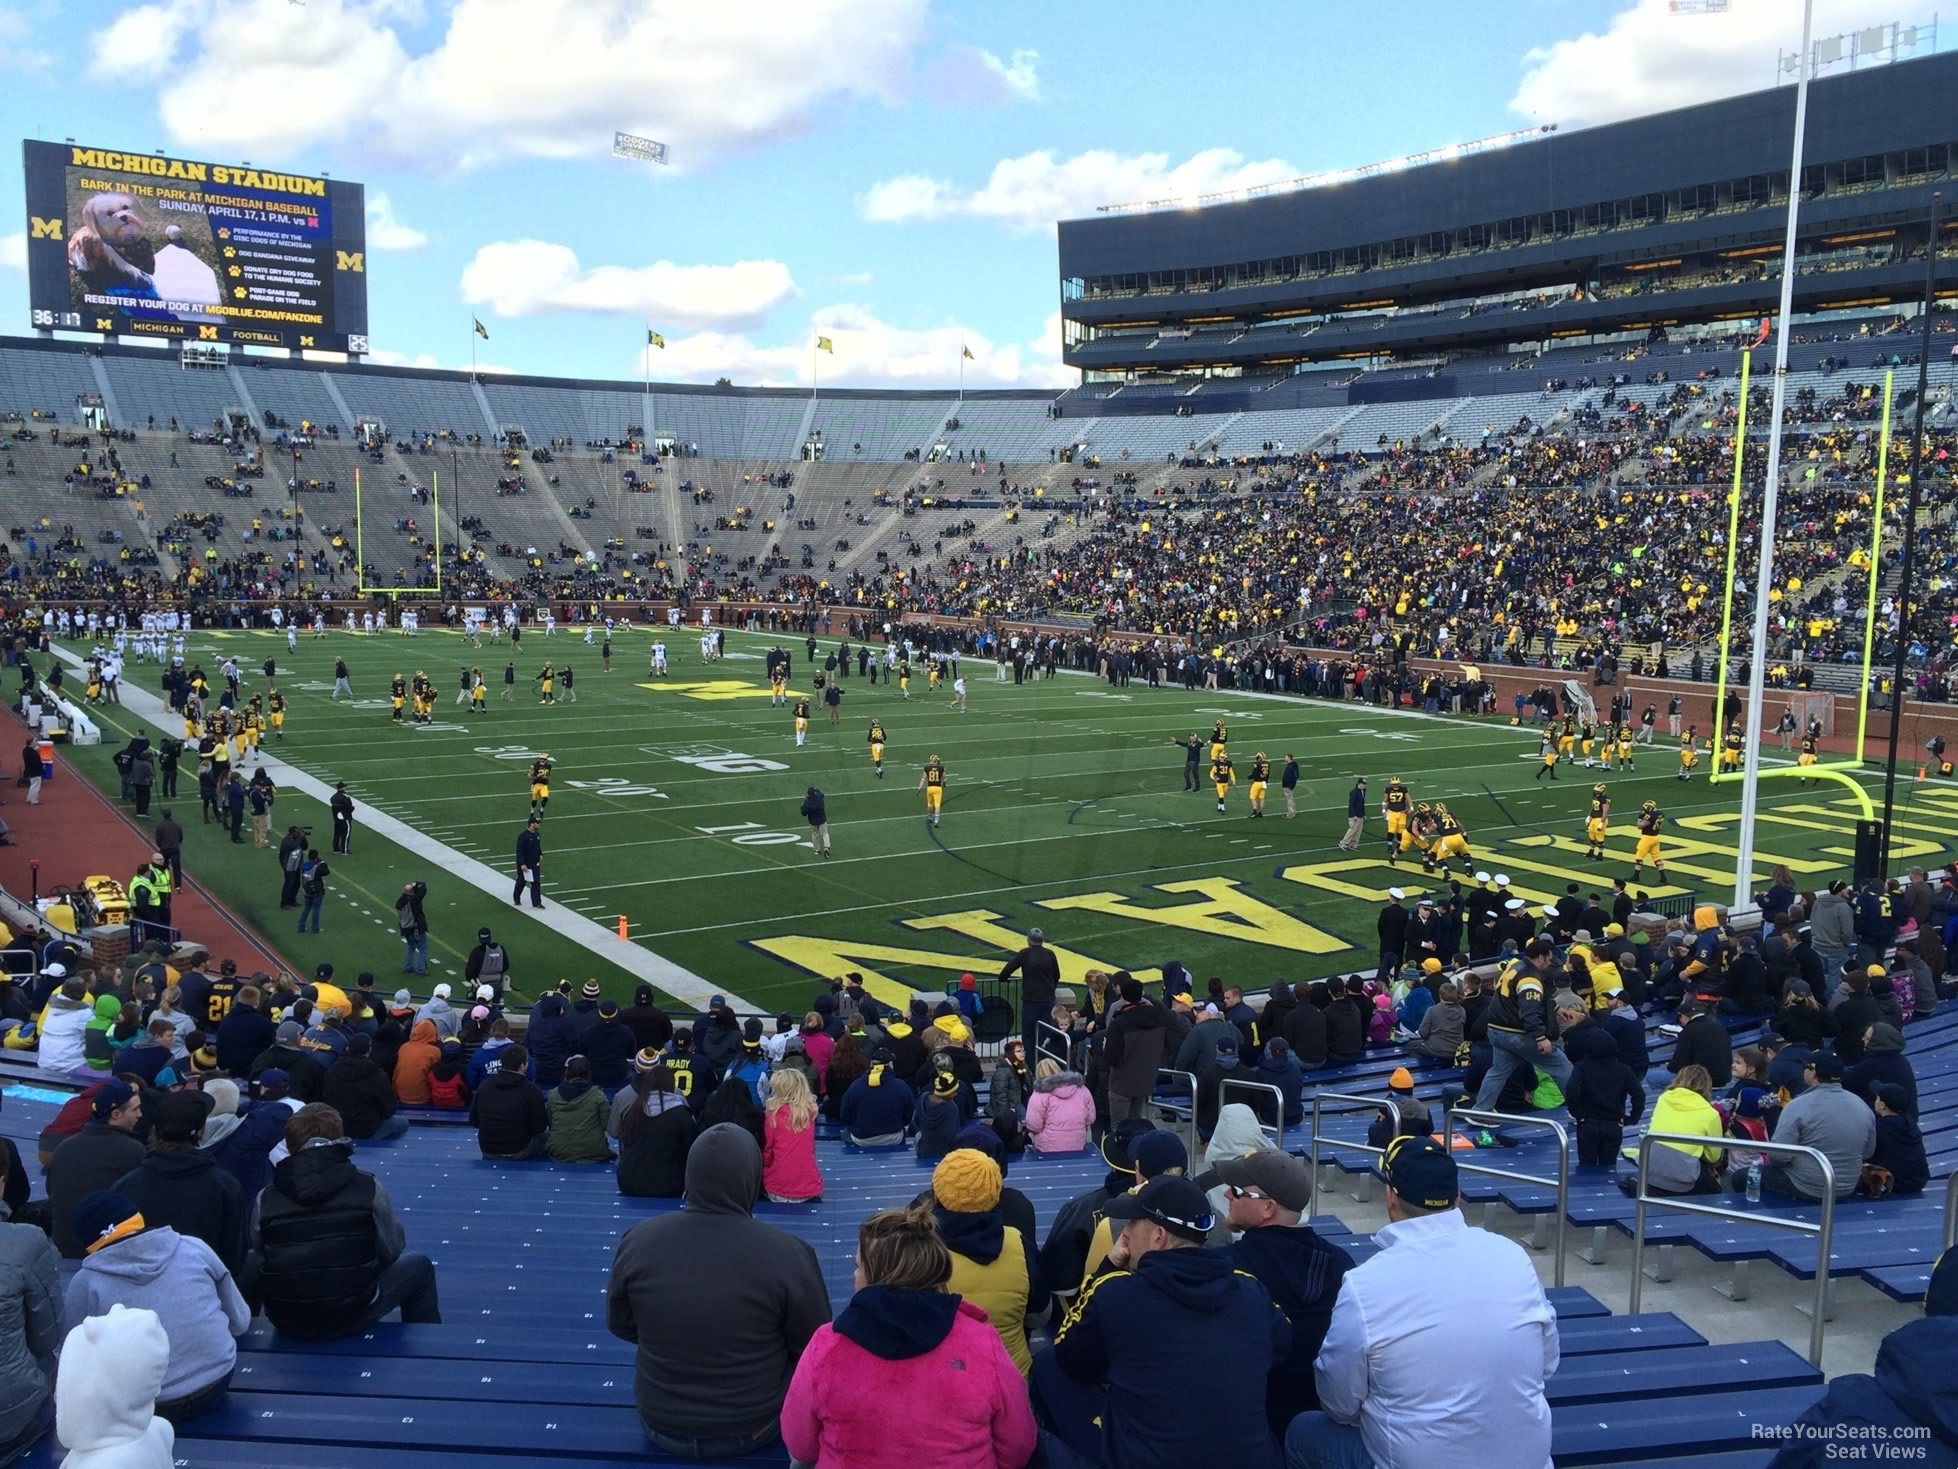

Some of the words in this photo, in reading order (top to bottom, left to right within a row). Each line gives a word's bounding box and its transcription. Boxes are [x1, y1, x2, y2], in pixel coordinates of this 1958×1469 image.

[72, 147, 206, 181] MICHIGAN
[213, 166, 325, 196] STADIUM
[80, 178, 112, 192] BARK
[115, 183, 129, 193] IN
[132, 184, 153, 196] THE
[156, 188, 186, 199] PARK
[189, 191, 202, 202] AT
[204, 193, 263, 209] MICHIGAN
[265, 201, 318, 217] BASEBALL
[159, 200, 207, 215] SUNDAY,
[208, 205, 242, 218] APRIL
[244, 210, 258, 221] 17,
[260, 212, 266, 220] 1
[268, 213, 291, 224] P.M.
[31, 216, 63, 240] M
[233, 227, 280, 239] PERFORMANCE
[251, 236, 268, 244] DOGS
[278, 239, 311, 249] MICHIGAN
[253, 251, 283, 260] BANDANA
[284, 255, 316, 264] GIVEAWAY
[336, 250, 363, 272] M
[243, 265, 268, 274] DONATE
[269, 268, 282, 276] DRY
[266, 275, 294, 284] HUMANE
[294, 278, 321, 286] SOCIETY
[249, 287, 285, 296] POST-GAME
[249, 294, 275, 302] PARADE
[298, 298, 316, 306] FIELD
[84, 293, 137, 306] REGISTER
[138, 298, 167, 310] YOUR
[168, 300, 190, 312] DOG
[191, 304, 204, 313] AT
[205, 305, 323, 324] MGOBLUE.COM/FANZONE
[96, 318, 113, 330] M
[133, 322, 184, 335] MICHIGAN
[198, 325, 218, 340] M
[233, 330, 280, 342] FOOTBALL
[300, 335, 314, 346] M
[350, 336, 368, 350] 25
[1219, 766, 1229, 775] 31
[1941, 762, 1952, 773] G
[928, 771, 939, 782] 81
[564, 777, 657, 796] 20
[1389, 792, 1404, 803] 57
[1442, 817, 1458, 830] 71
[695, 821, 802, 845] 10
[1879, 896, 1892, 918] 2
[1700, 949, 1707, 958] 5
[1526, 991, 1541, 1002] U-M
[208, 995, 231, 1022] 21
[1250, 1020, 1261, 1047] 1
[175, 1459, 189, 1467] 12
